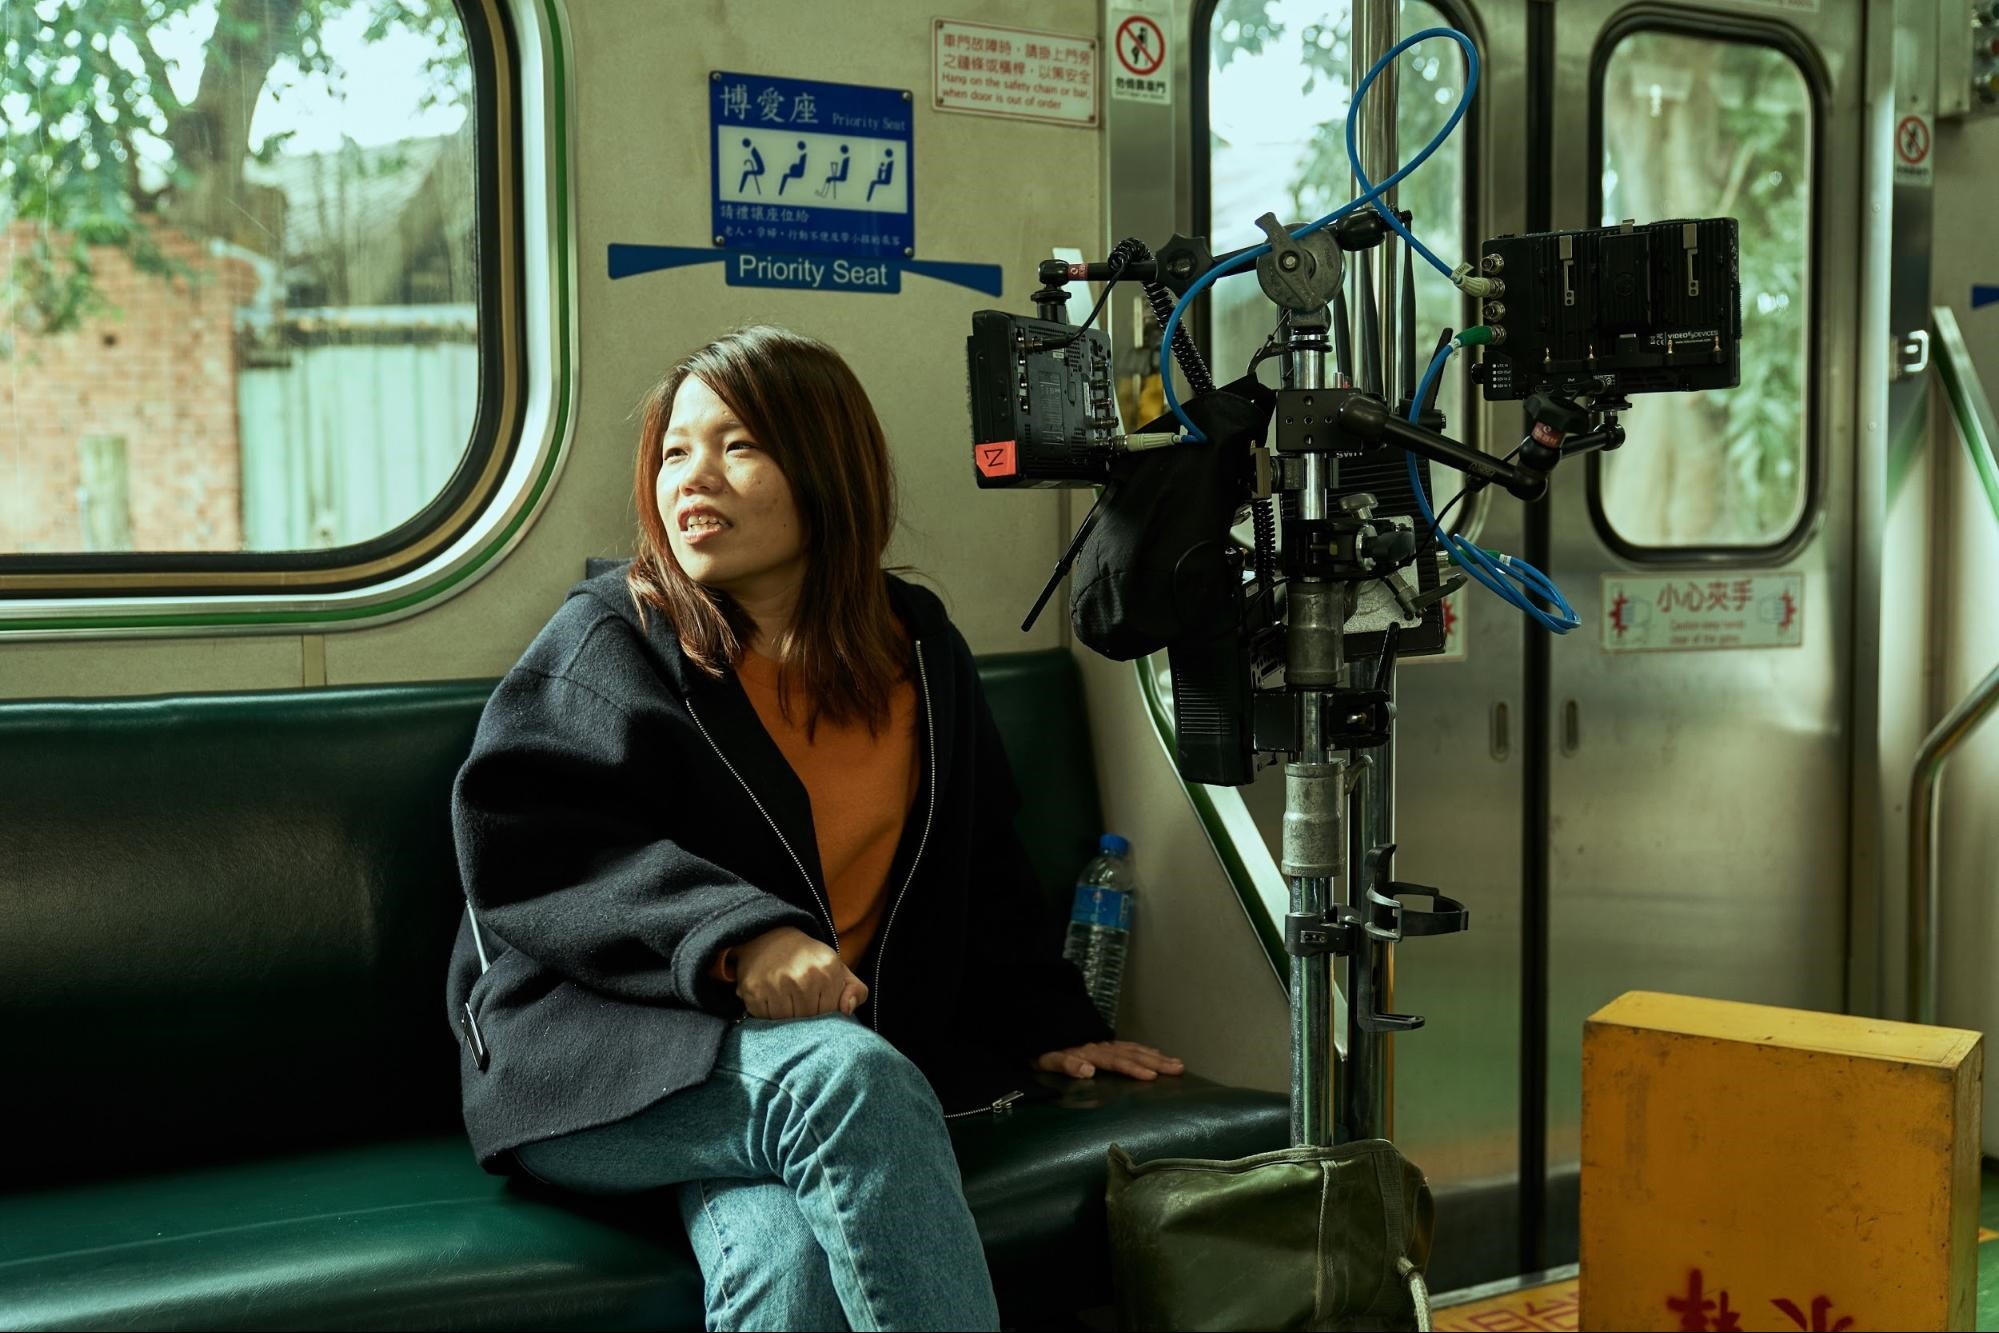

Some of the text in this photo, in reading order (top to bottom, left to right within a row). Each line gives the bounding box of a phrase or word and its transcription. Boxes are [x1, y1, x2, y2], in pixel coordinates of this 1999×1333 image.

[942, 72, 967, 86] Hang
[969, 76, 983, 85] on
[985, 75, 1000, 87] the
[1003, 79, 1031, 93] safety
[1033, 82, 1058, 95] chain
[1060, 86, 1071, 96] or
[720, 84, 819, 124] 博愛座
[942, 88, 1062, 110] when door is out of order
[832, 112, 906, 132] Priority Seat
[738, 254, 888, 287] Priority Seat
[1656, 578, 1753, 613] 小心夾手
